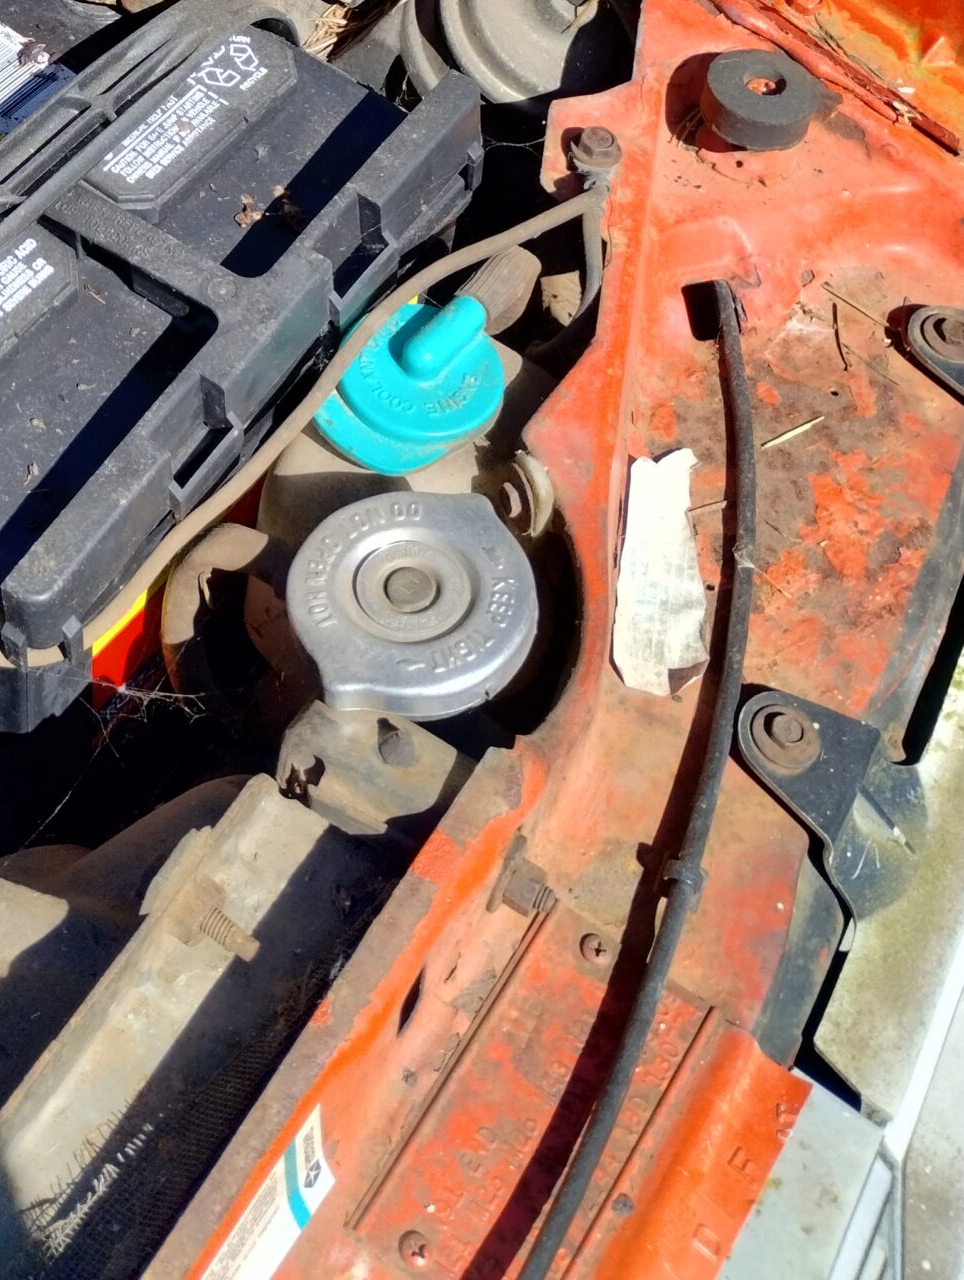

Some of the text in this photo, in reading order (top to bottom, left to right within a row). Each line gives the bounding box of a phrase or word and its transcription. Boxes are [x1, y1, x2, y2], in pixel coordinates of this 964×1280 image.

[134, 136, 151, 153] FOR
[12, 235, 38, 260] ACID
[0, 259, 28, 287] CAUSE
[347, 506, 386, 540] NOT
[389, 501, 423, 521] DO
[304, 535, 343, 587] OPEN
[303, 591, 338, 629] HOT
[430, 577, 520, 674] KEEP TIGHT
